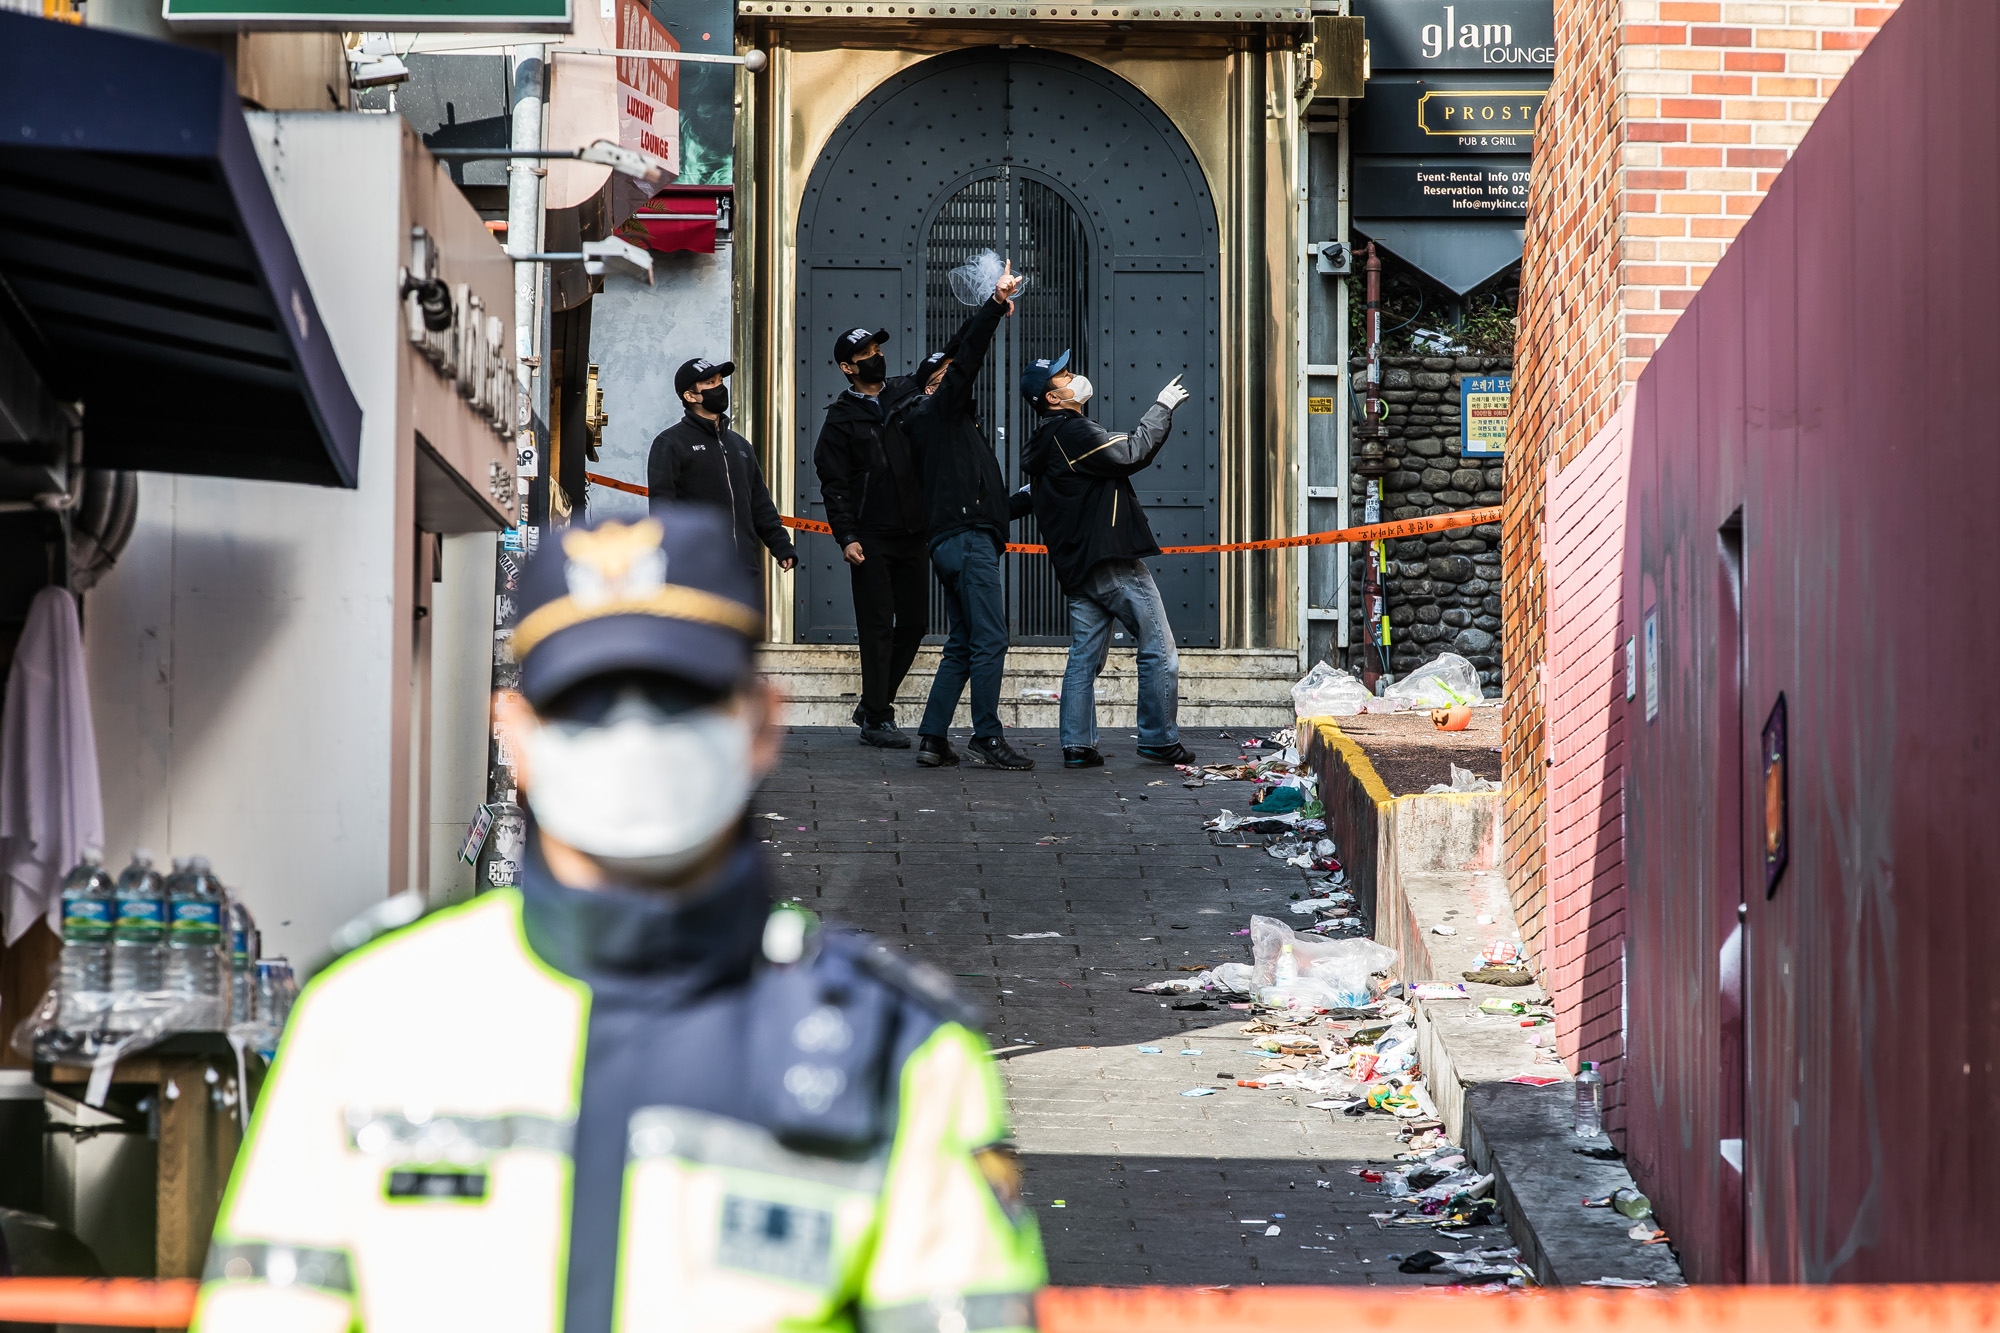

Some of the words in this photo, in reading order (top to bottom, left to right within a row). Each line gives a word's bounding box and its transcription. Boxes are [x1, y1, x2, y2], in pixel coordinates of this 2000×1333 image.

[1421, 5, 1512, 59] glam
[621, 4, 651, 96] 108
[1483, 47, 1555, 64] LOUNGE
[626, 94, 655, 126] LUXURY
[1444, 106, 1532, 120] PROST
[640, 129, 669, 161] LOUNGE
[1458, 136, 1477, 146] PUB
[1480, 136, 1488, 146] &
[1491, 136, 1517, 146] GRILL
[1488, 172, 1509, 182] Info
[1423, 185, 1483, 195] Reservation
[1488, 185, 1509, 195] Info
[1472, 380, 1495, 392] 쓰레기
[1408, 520, 1434, 534] 이선을
